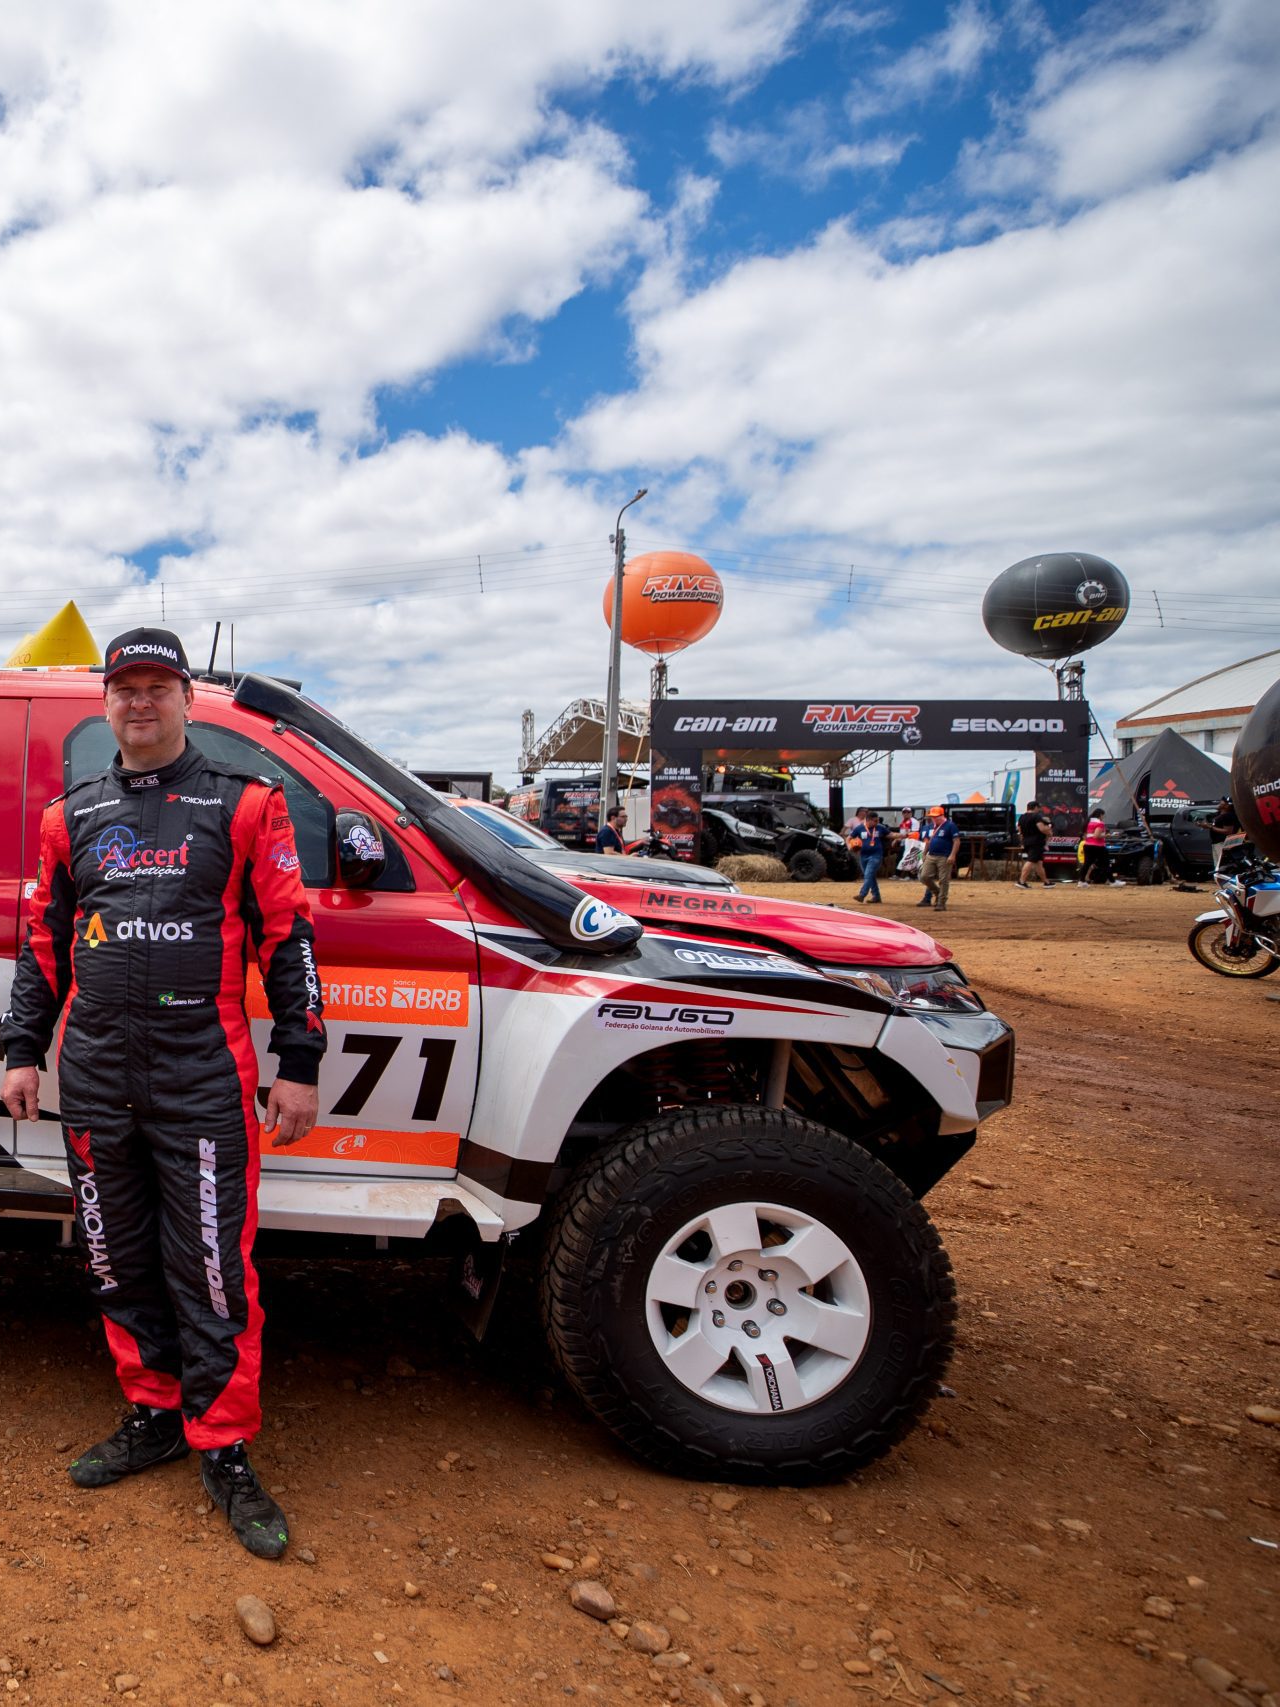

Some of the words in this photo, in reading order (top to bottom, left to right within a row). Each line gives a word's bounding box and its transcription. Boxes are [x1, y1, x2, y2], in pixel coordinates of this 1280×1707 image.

[122, 644, 178, 662] YOKOHAMA
[673, 716, 777, 732] can-am
[802, 704, 921, 724] RIVER
[813, 722, 903, 733] POWERSPORTS
[180, 795, 222, 806] YOKOHAMA
[98, 841, 189, 871] Accert
[647, 892, 753, 915] NEGRÃO
[116, 917, 193, 941] atvos
[304, 938, 319, 1010] YOKOHAM
[321, 982, 388, 1007] ERTÕES
[416, 988, 462, 1011] BRB
[605, 1021, 639, 1030] Federação
[640, 1024, 664, 1032] Goiana
[674, 1026, 725, 1035] Automobilismo
[77, 1171, 119, 1292] YOKOHAMA
[198, 1138, 231, 1320] GEOLANDAR
[765, 1365, 782, 1410] YOKOHAMA
